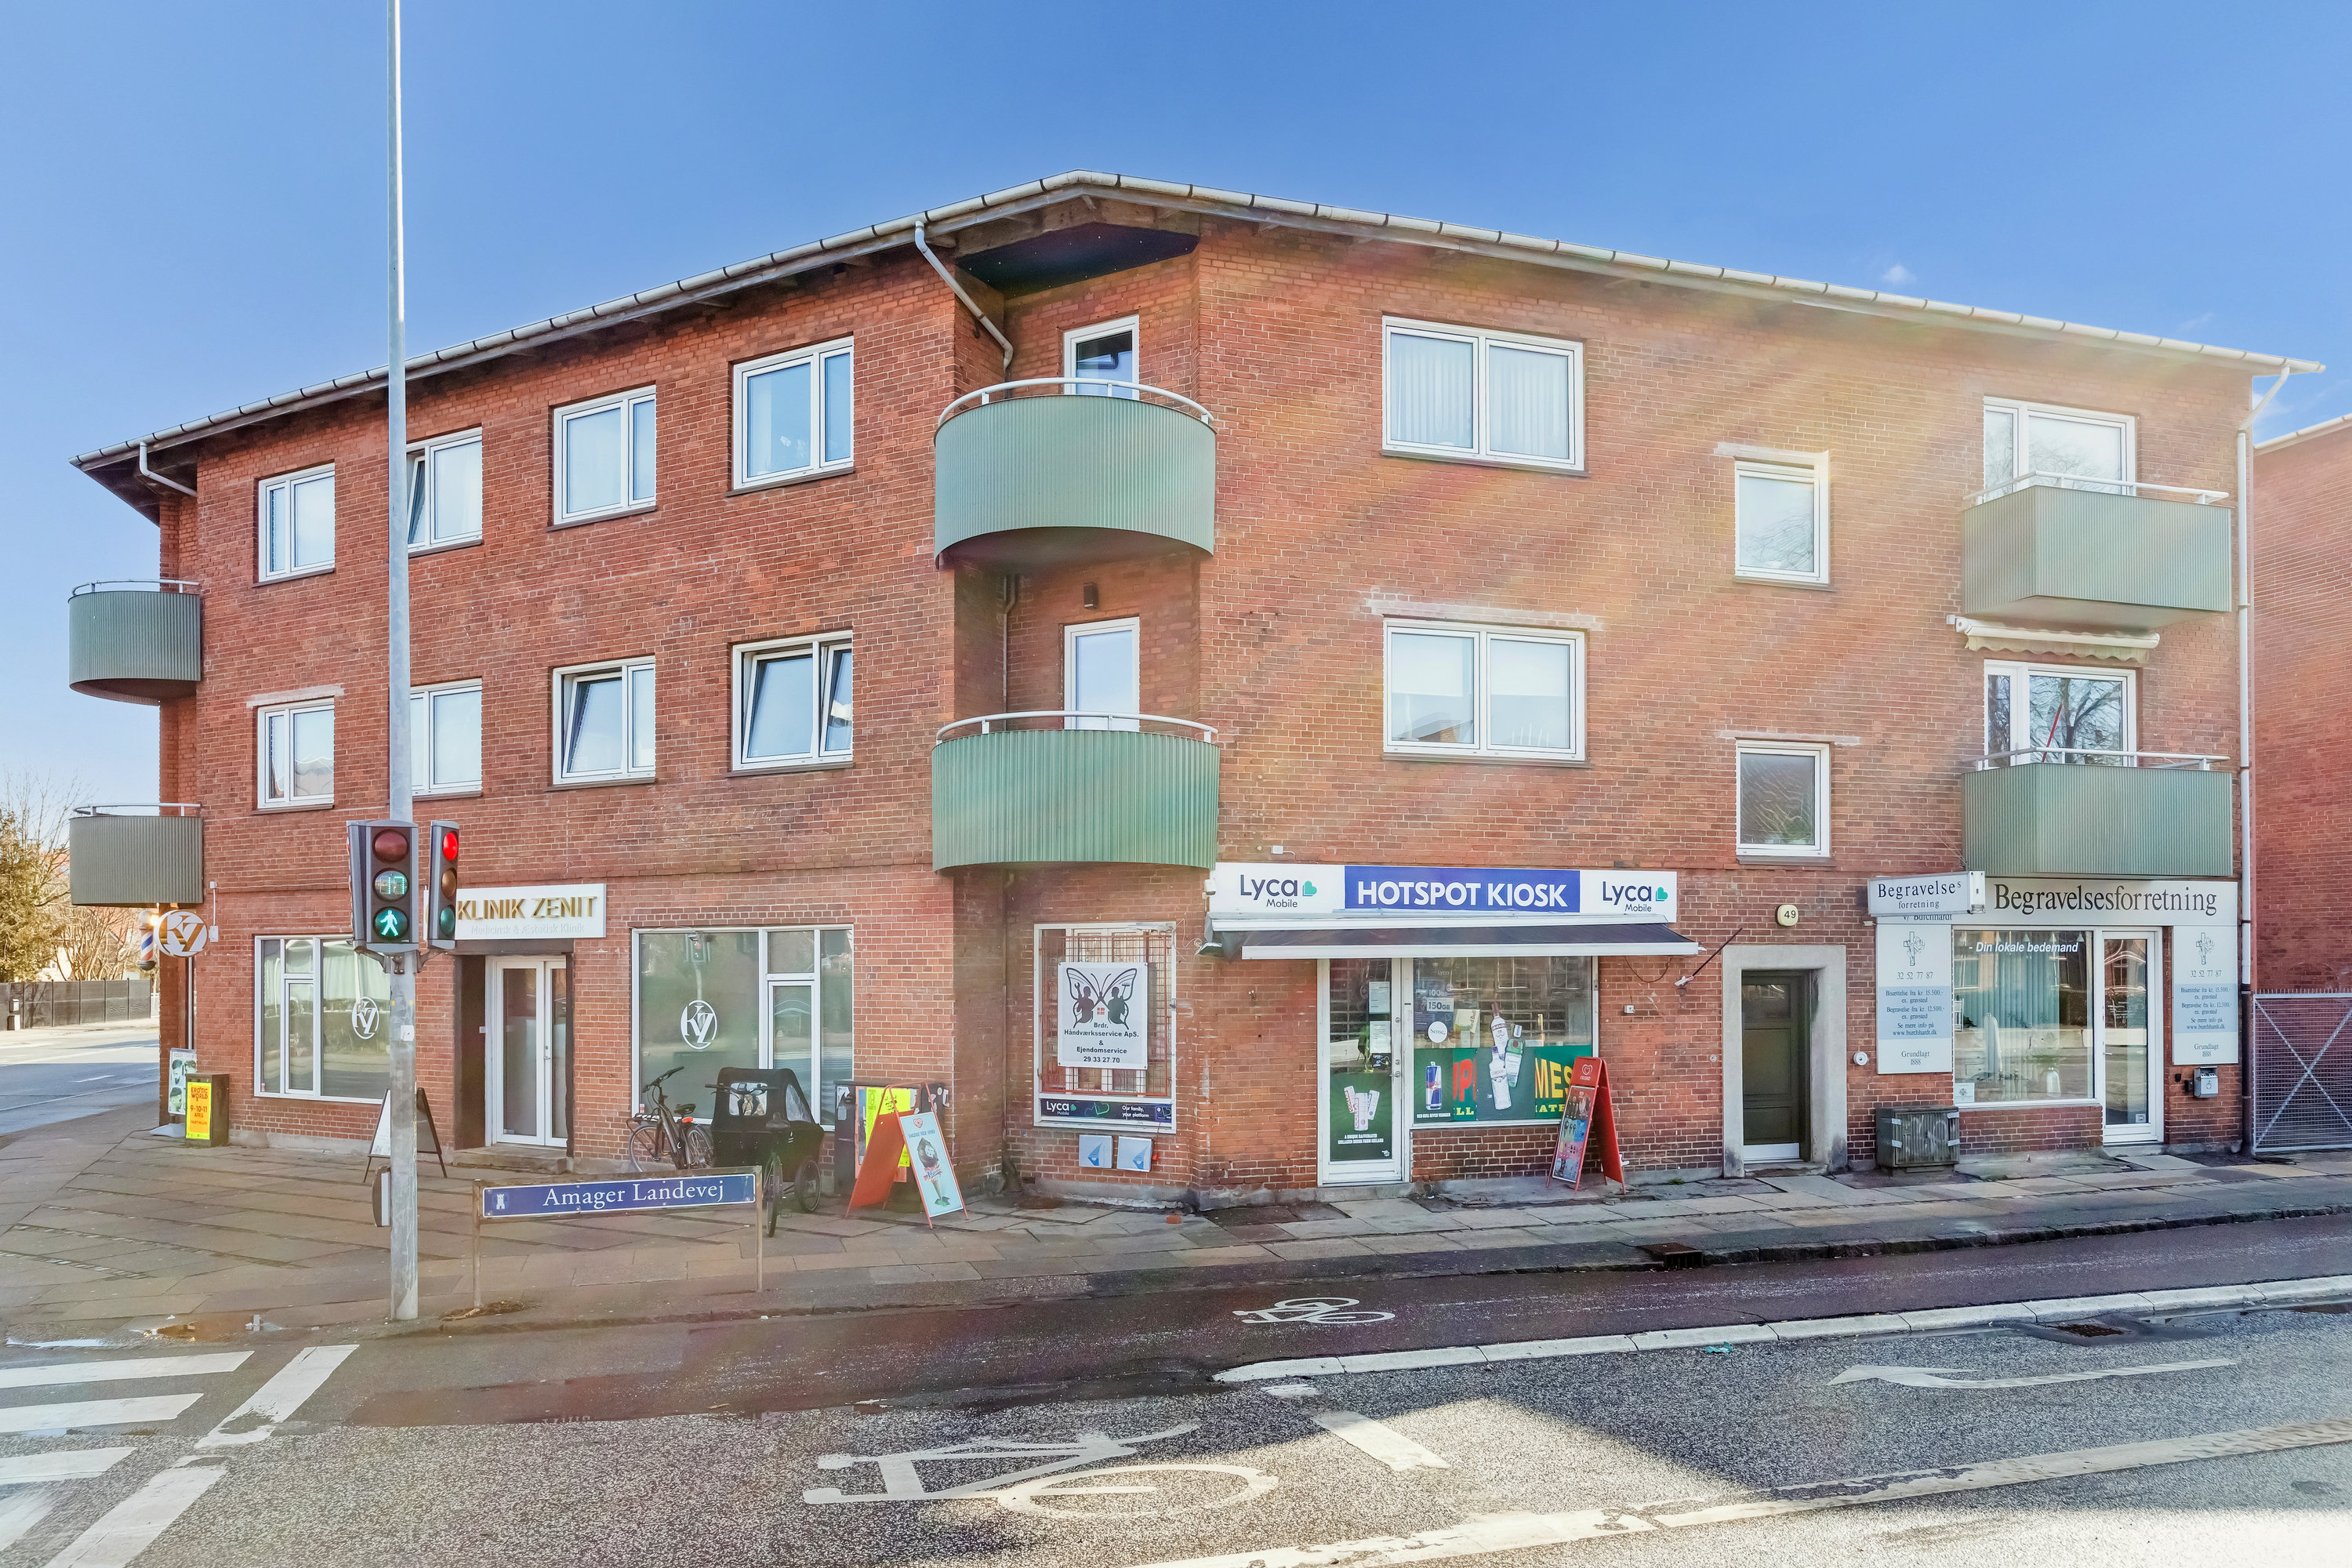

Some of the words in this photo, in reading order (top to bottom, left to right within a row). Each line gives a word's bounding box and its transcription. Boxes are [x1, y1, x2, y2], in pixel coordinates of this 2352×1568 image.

[1240, 874, 1298, 900] Lyca
[1602, 881, 1651, 905] Lyca
[1358, 880, 1481, 906] HOTSPOT
[1488, 883, 1568, 907] KIOSK
[1266, 898, 1298, 908] Mobile
[1898, 900, 1940, 909] forretning
[1994, 884, 2216, 916] Begravelsesforretning
[458, 898, 525, 920] KLINIK
[532, 896, 597, 918] ZENIT
[1625, 903, 1652, 912] Mobile
[1784, 910, 1796, 919] 49
[471, 924, 510, 935] Medicinsk
[513, 924, 520, 933] &
[561, 922, 585, 933] Klinik
[1976, 942, 1993, 952] Din
[1995, 942, 2024, 952] lokale
[2027, 942, 2078, 953] bedemand
[1428, 1001, 1450, 1010] 150GB
[1046, 1101, 1069, 1112] Lyca
[543, 1188, 626, 1209] Amager
[633, 1180, 724, 1203] Landevej
